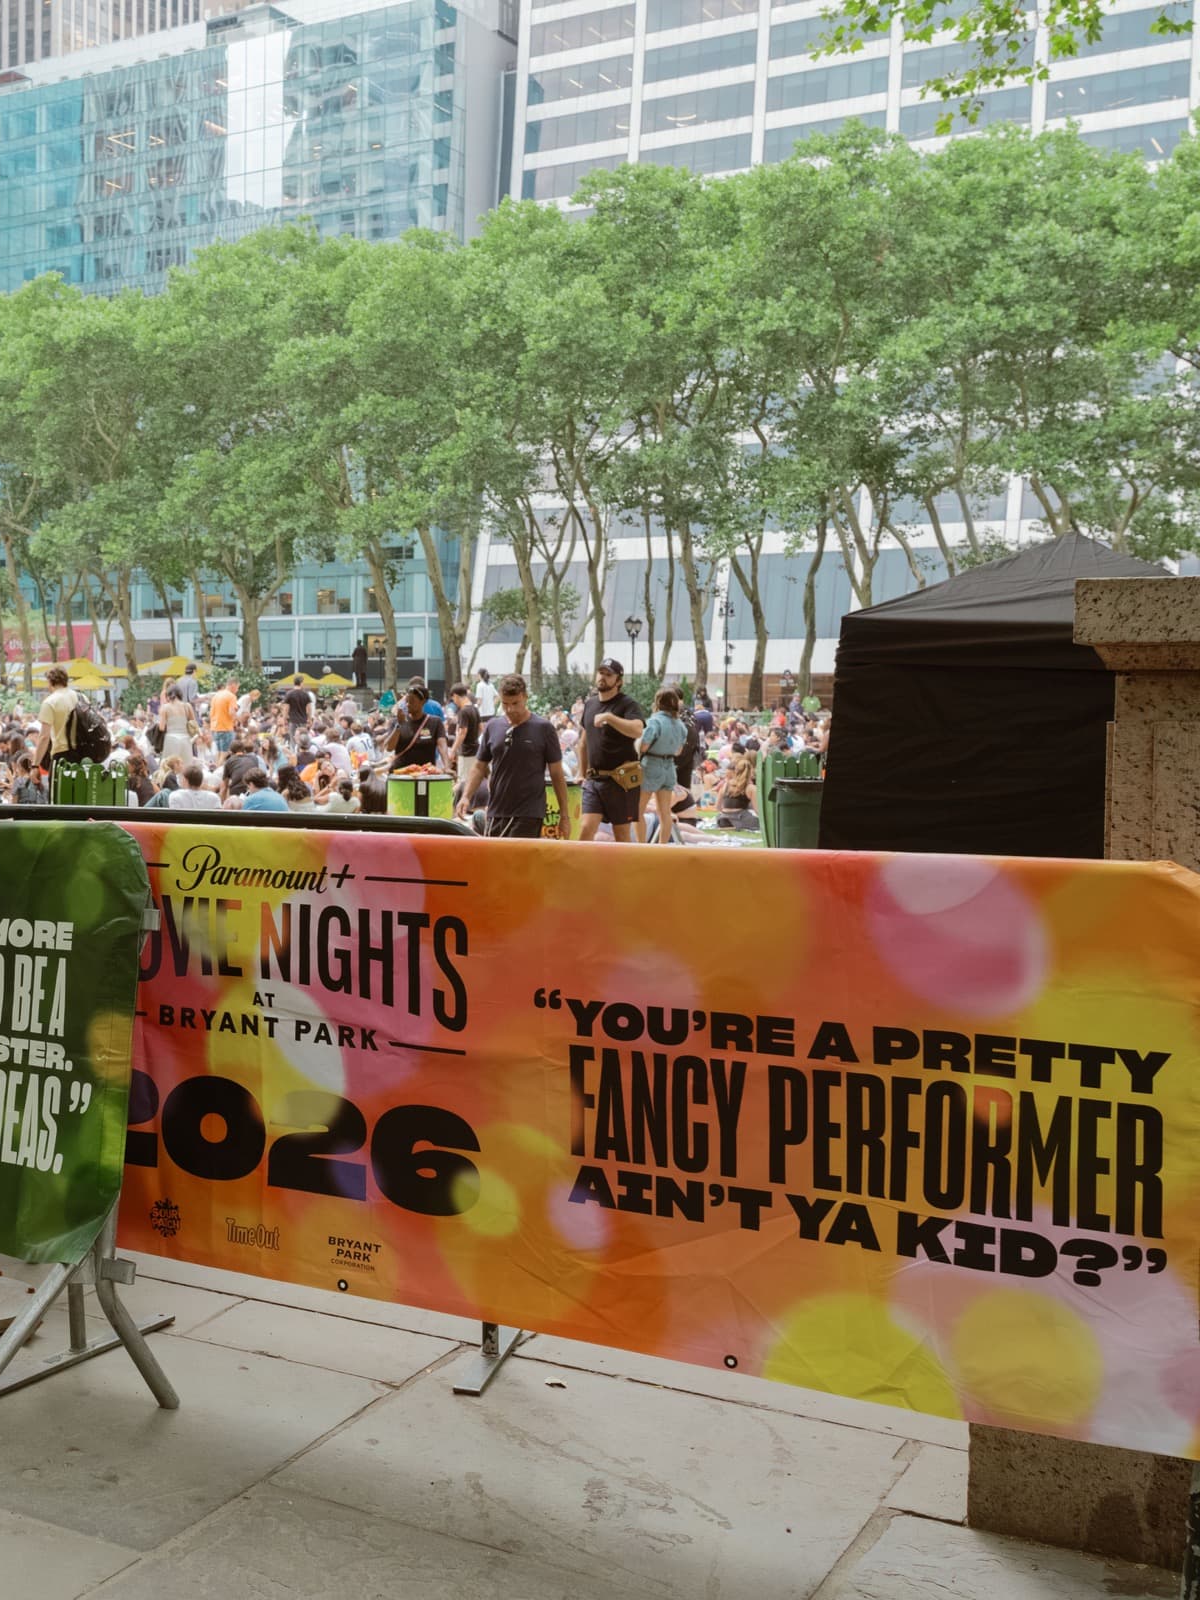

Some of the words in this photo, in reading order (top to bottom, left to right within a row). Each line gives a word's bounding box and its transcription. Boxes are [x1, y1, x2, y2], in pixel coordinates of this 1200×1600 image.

[176, 844, 356, 894] Paramount+
[260, 901, 469, 1033] NIGHTS
[11, 956, 49, 1036] BE
[49, 957, 66, 1037] A
[252, 991, 275, 1007] AT
[159, 1004, 278, 1039] BRYANT
[294, 1024, 379, 1051] PARK
[807, 1022, 860, 1063] A
[872, 1025, 1172, 1095] PRETTY
[568, 1044, 747, 1178] FANCY
[767, 1066, 1165, 1239] PERFORMER
[567, 1165, 773, 1231] AIN’T
[785, 1194, 881, 1252] YA
[328, 1236, 382, 1254] BRYANT
[330, 1257, 375, 1272] CORPORATION
[336, 1248, 372, 1263] PARK
